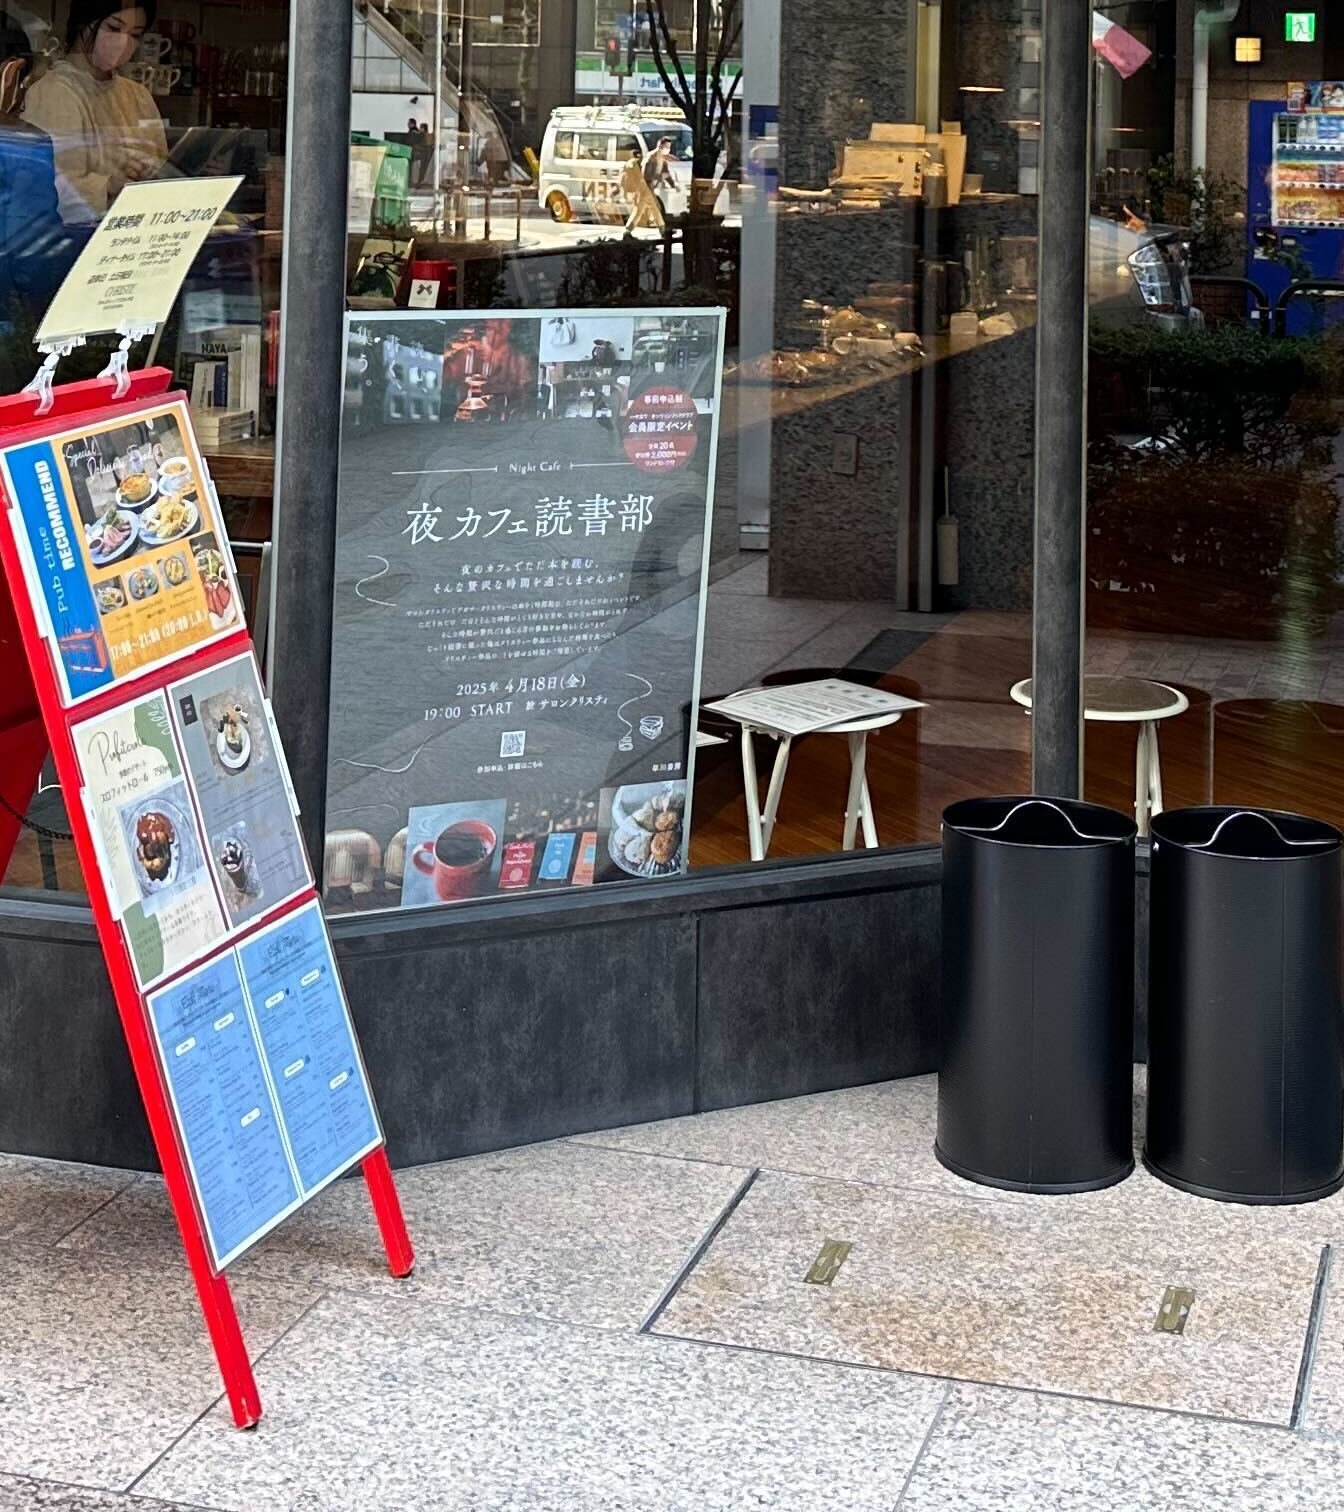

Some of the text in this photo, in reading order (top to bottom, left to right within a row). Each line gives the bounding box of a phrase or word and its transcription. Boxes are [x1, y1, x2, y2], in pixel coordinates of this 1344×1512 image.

[629, 420, 694, 433] 会員限定イベント
[509, 461, 537, 475] Night
[34, 460, 76, 572] RECOMMEND
[402, 493, 655, 545] 夜カフェ読書部
[38, 526, 57, 569] time
[423, 707, 461, 721] 19:00
[470, 702, 513, 717] START
